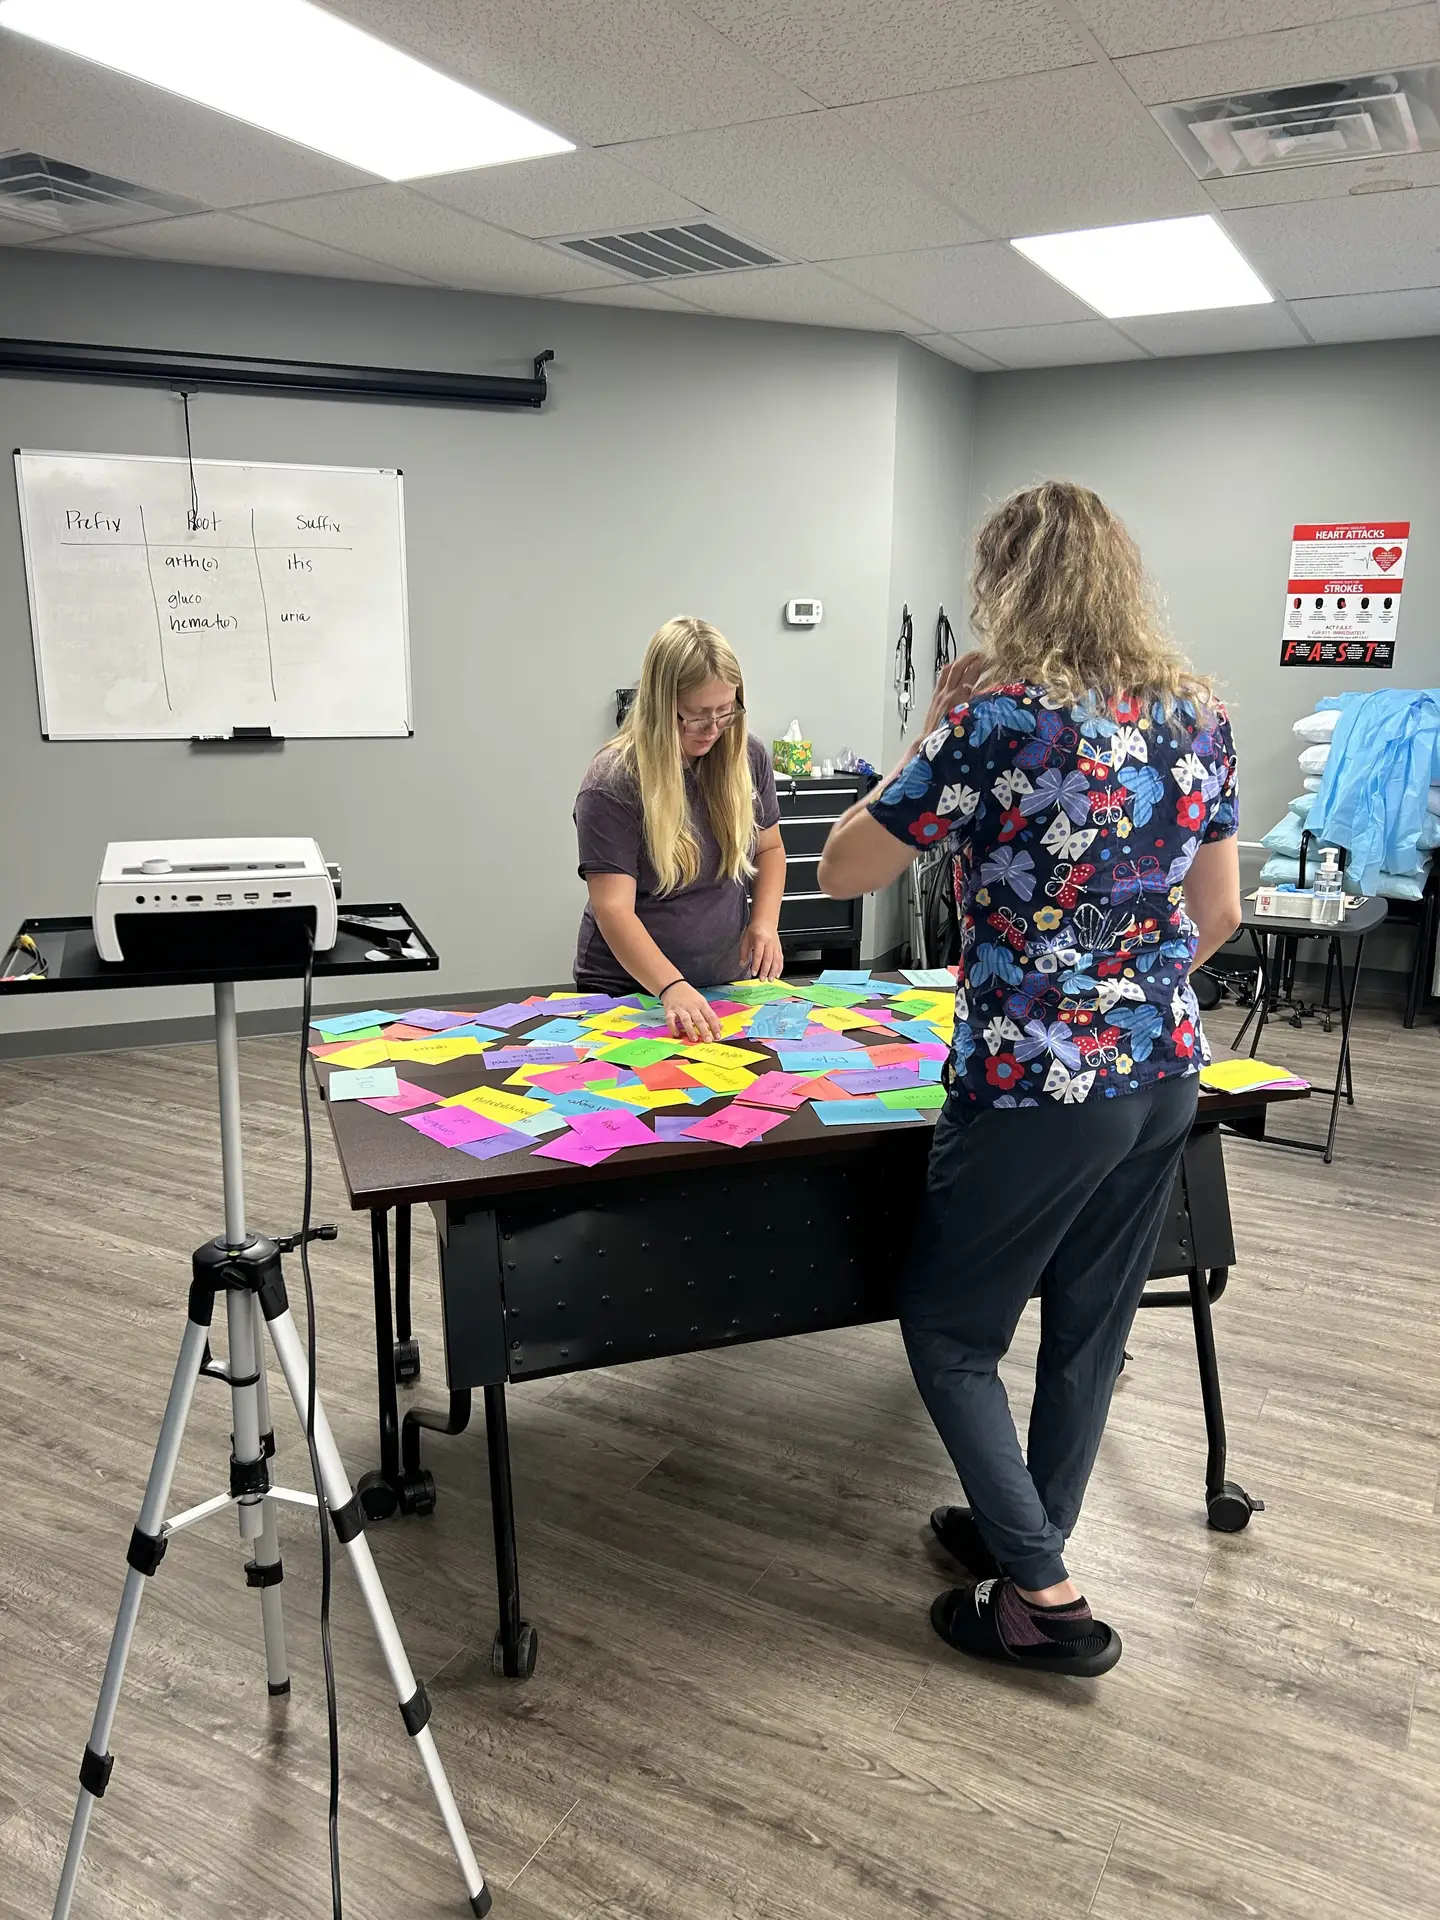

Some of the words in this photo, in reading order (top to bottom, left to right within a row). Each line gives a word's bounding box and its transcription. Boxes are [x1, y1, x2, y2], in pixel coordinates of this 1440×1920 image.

[65, 510, 122, 532] Prefix
[187, 509, 222, 531] Root
[296, 515, 341, 532] Suffix
[1315, 530, 1346, 540] HEART
[1346, 529, 1385, 539] ATTACKS
[164, 553, 219, 571] arth(o)
[287, 557, 313, 572] itis
[1324, 584, 1364, 593] STROKES
[167, 591, 202, 609] gluco
[280, 611, 311, 622] uria
[1284, 642, 1297, 661] F
[1308, 642, 1322, 662] A
[1336, 642, 1349, 662] S
[1365, 643, 1378, 662] T
